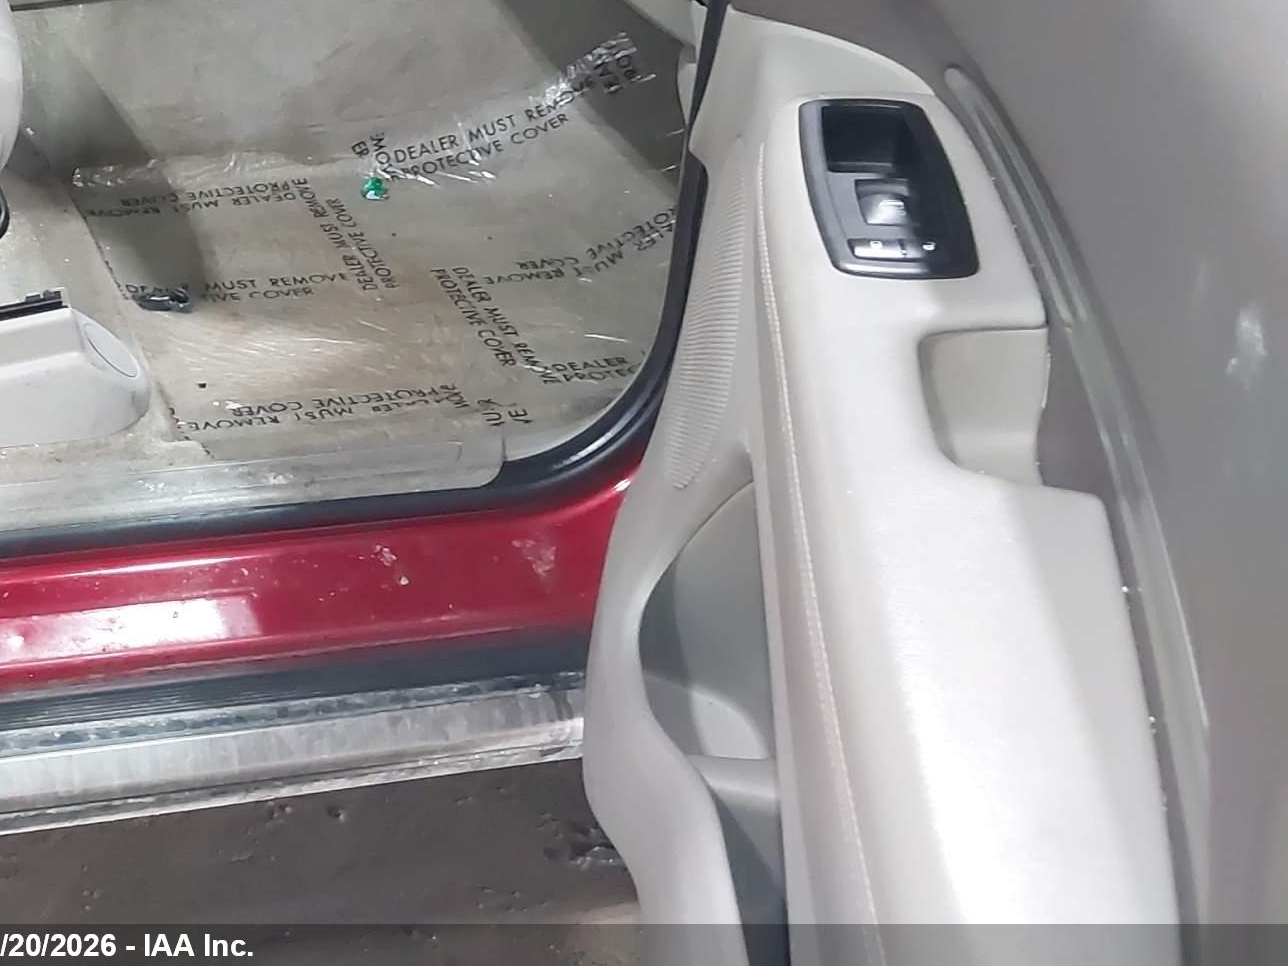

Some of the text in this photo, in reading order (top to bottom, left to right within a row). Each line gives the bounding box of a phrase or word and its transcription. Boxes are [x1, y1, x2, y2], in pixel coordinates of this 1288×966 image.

[394, 134, 460, 164] DEALER
[468, 114, 516, 143] MUST
[511, 113, 571, 145] COVER
[187, 180, 291, 201] PROTECTIVE
[231, 190, 297, 207] DEALER
[171, 199, 220, 214] MUST
[320, 222, 351, 250] MUST
[326, 197, 399, 289] PROTECTIVE COVER
[343, 254, 379, 291] DEALER
[483, 269, 565, 285] REMOVE
[205, 278, 258, 291] MUST
[452, 266, 492, 303] DEALER
[484, 307, 520, 338] MUST
[430, 267, 488, 328] PROTECTIVE
[478, 328, 517, 367] COVER
[553, 356, 629, 372] DEALER
[312, 387, 438, 408] PROTECTIVE
[232, 400, 304, 417] COVER
